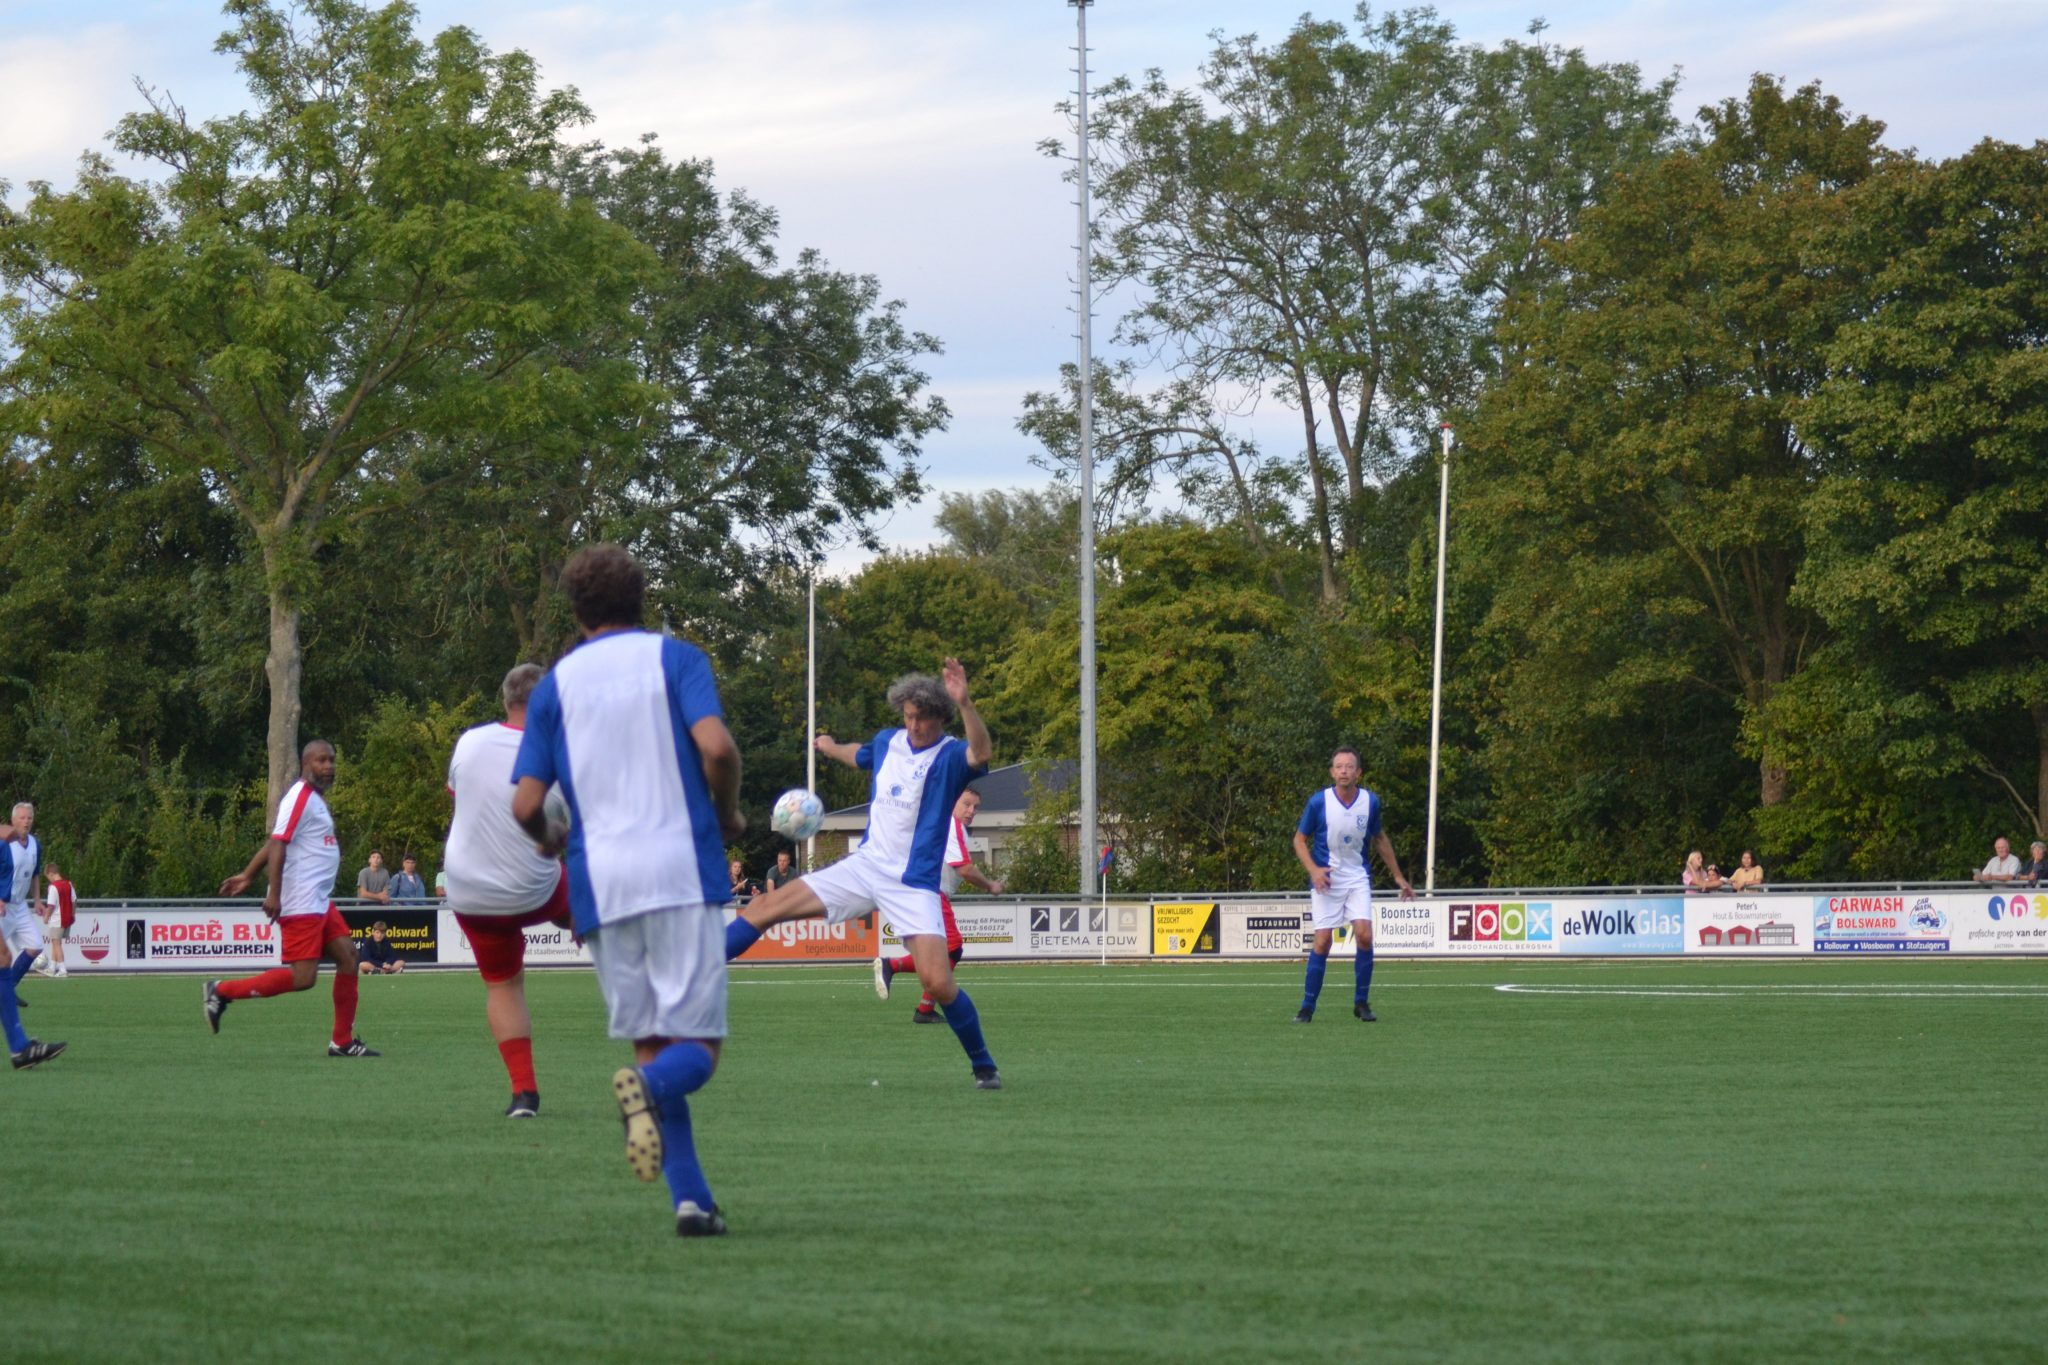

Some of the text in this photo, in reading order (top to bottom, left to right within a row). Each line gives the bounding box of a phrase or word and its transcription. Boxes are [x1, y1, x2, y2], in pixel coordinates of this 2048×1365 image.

[1736, 902, 1758, 911] Peter's
[1829, 897, 1903, 912] CARWASH
[1381, 907, 1429, 919] Boonstra
[1712, 912, 1727, 921] Hout
[1735, 911, 1782, 921] Bouwmaterialen
[1249, 920, 1299, 928] RESTAURANT
[1453, 909, 1551, 936] FOOX
[1837, 918, 1896, 929] BOLSWARD
[386, 926, 429, 939] olsward
[1381, 922, 1435, 938] Makelaardij
[1996, 930, 2014, 940] groep
[2016, 930, 2031, 938] van
[2032, 929, 2047, 938] der
[524, 931, 561, 944] sward
[1246, 932, 1301, 949] FOLKERTS
[151, 944, 274, 956] METSELWERKEN
[406, 942, 418, 950] per
[806, 944, 866, 956] tegelwalhalla
[1824, 942, 1850, 950] Rollover
